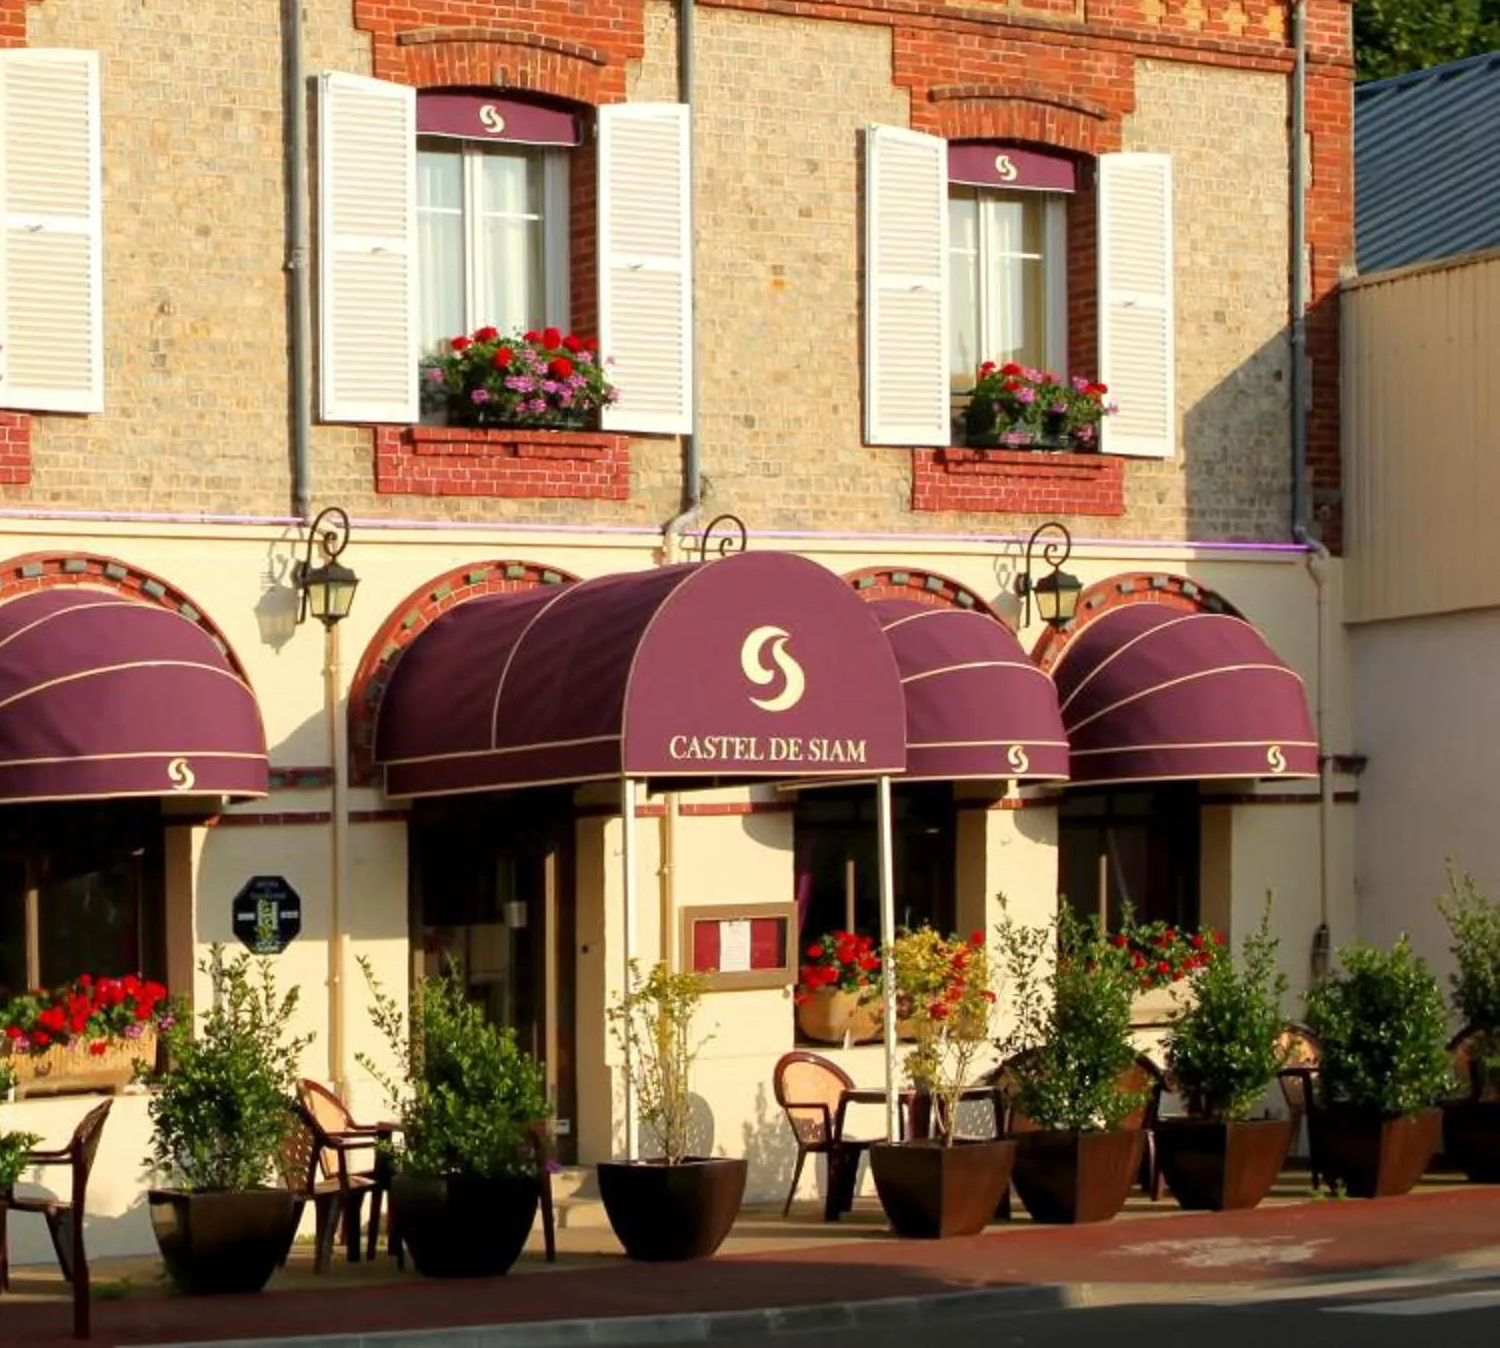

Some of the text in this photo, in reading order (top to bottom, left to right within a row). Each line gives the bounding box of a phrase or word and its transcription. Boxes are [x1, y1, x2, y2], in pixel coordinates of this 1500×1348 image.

[668, 735, 867, 763] CASTEL DE SIAM
